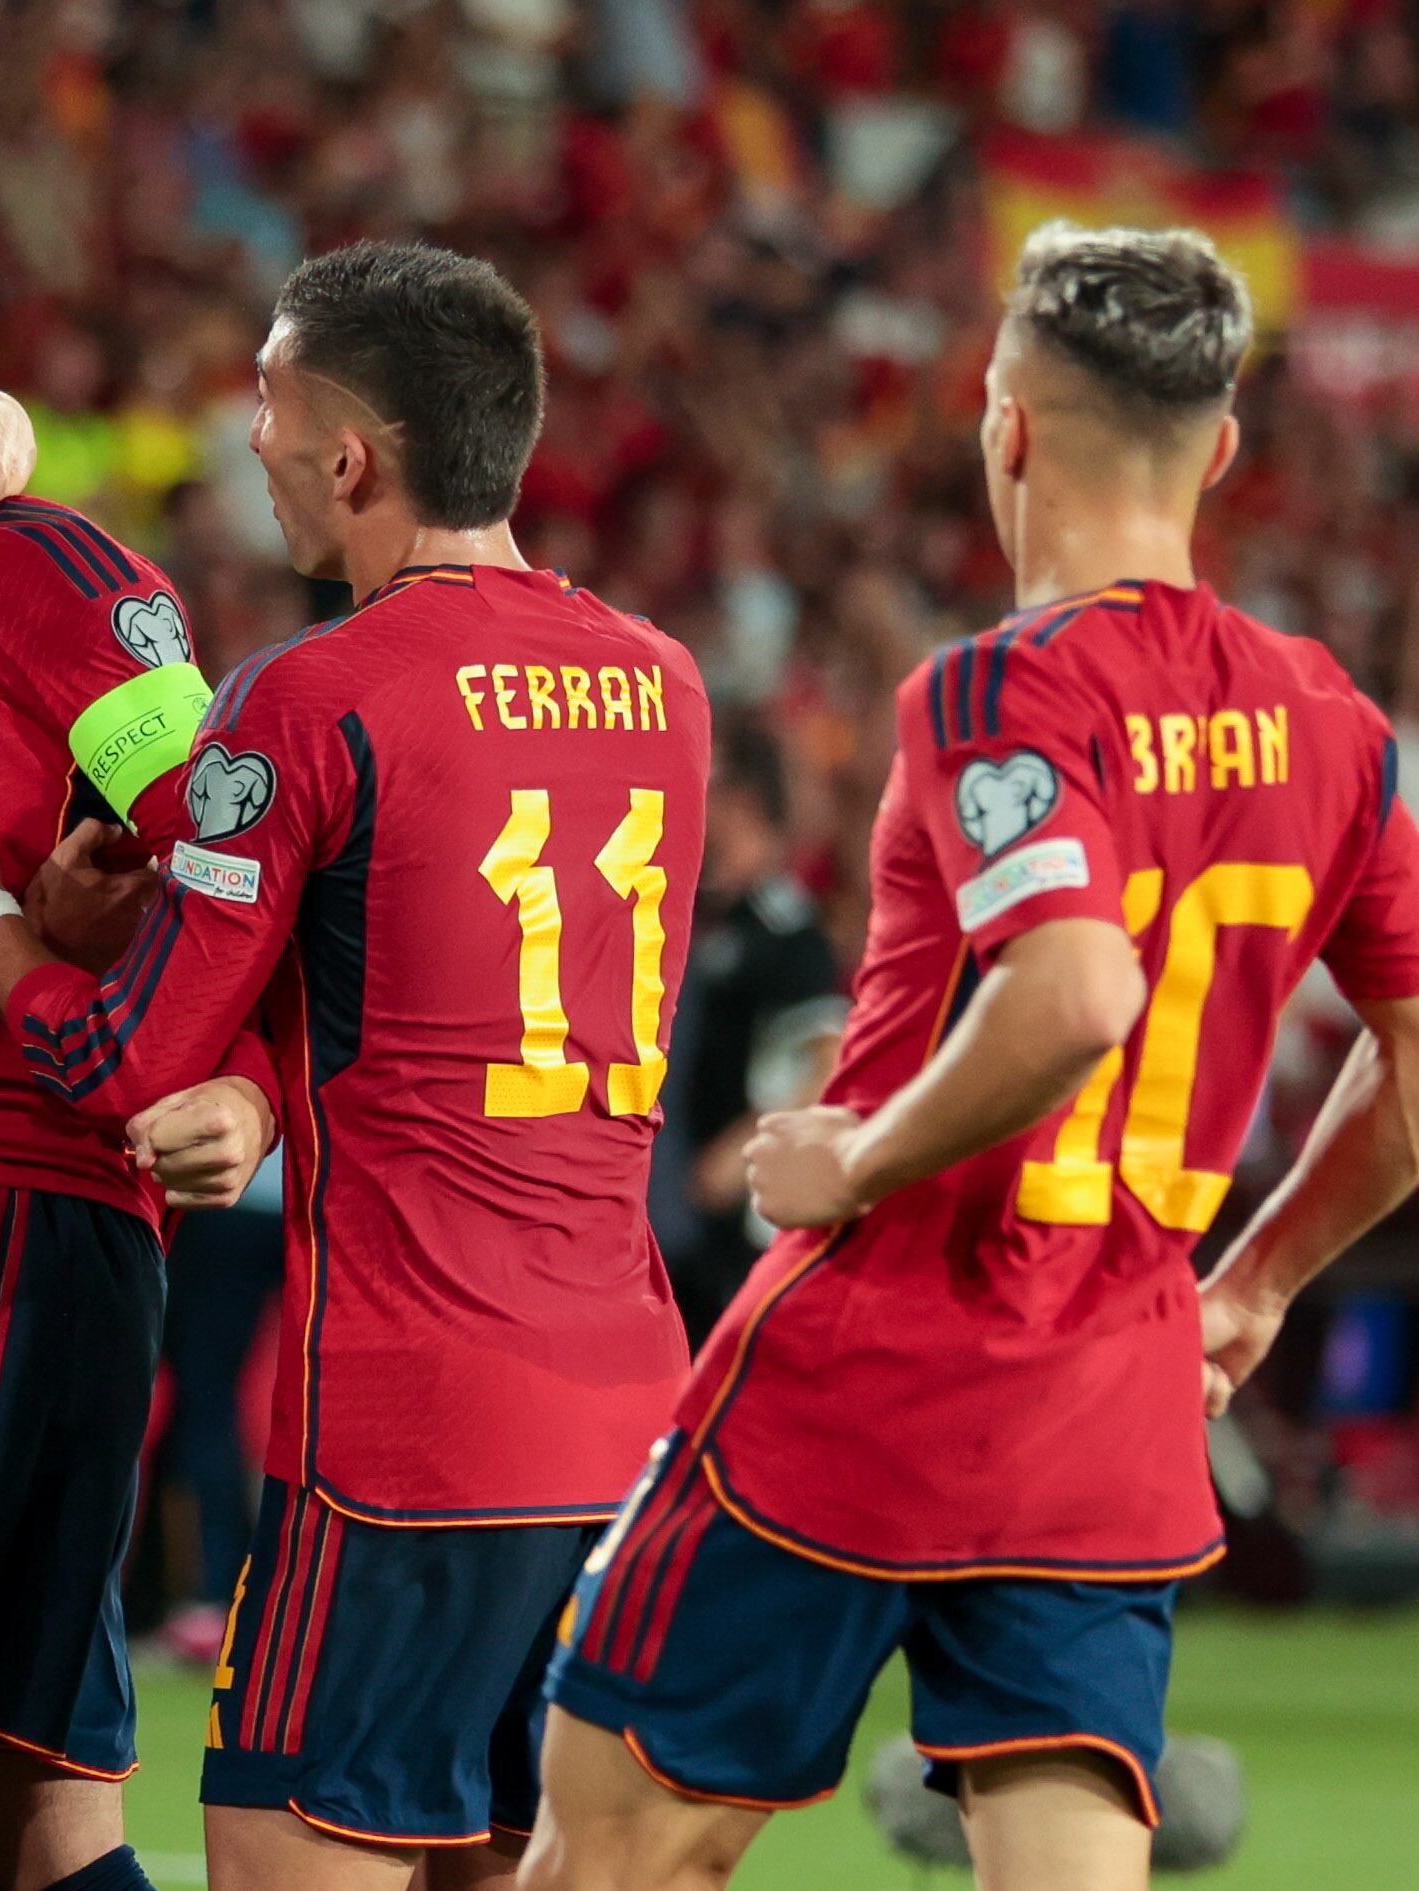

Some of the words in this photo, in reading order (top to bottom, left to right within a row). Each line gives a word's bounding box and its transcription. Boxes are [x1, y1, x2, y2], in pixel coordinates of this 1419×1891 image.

[455, 664, 668, 732] FERRAN
[91, 711, 167, 786] RESPECT
[1124, 704, 1289, 795] BRAN
[478, 788, 668, 1118] 11
